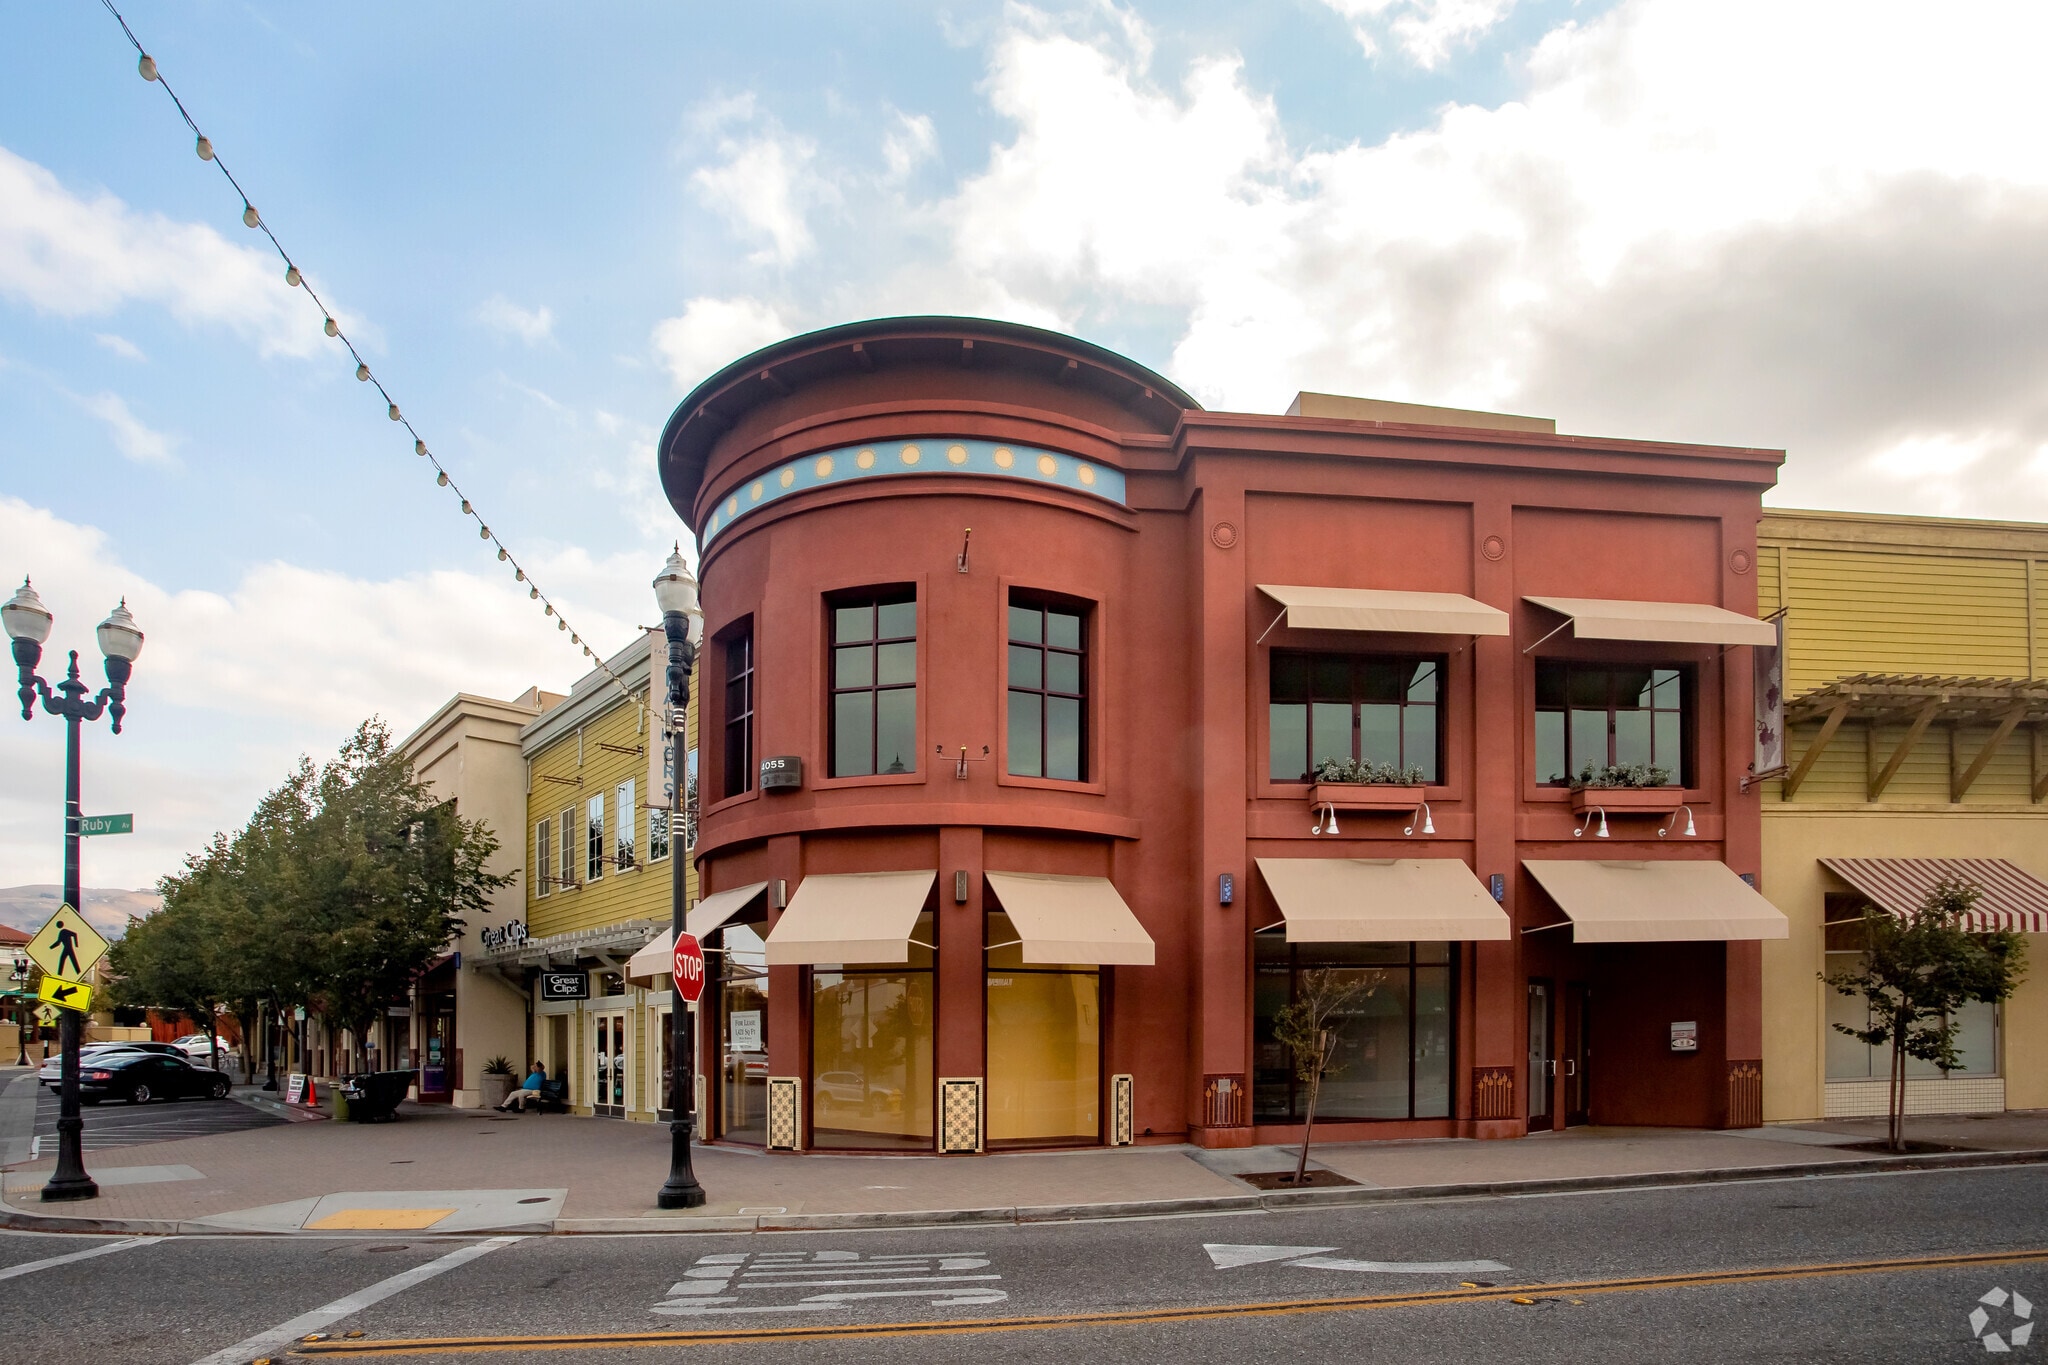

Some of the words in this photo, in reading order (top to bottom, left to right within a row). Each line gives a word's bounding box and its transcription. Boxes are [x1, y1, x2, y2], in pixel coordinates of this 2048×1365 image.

[81, 819, 112, 833] Ruby
[481, 926, 505, 947] Great
[675, 952, 703, 982] STOP
[550, 975, 579, 985] Great
[553, 984, 578, 995] Clips
[648, 1250, 1009, 1316] STOP
